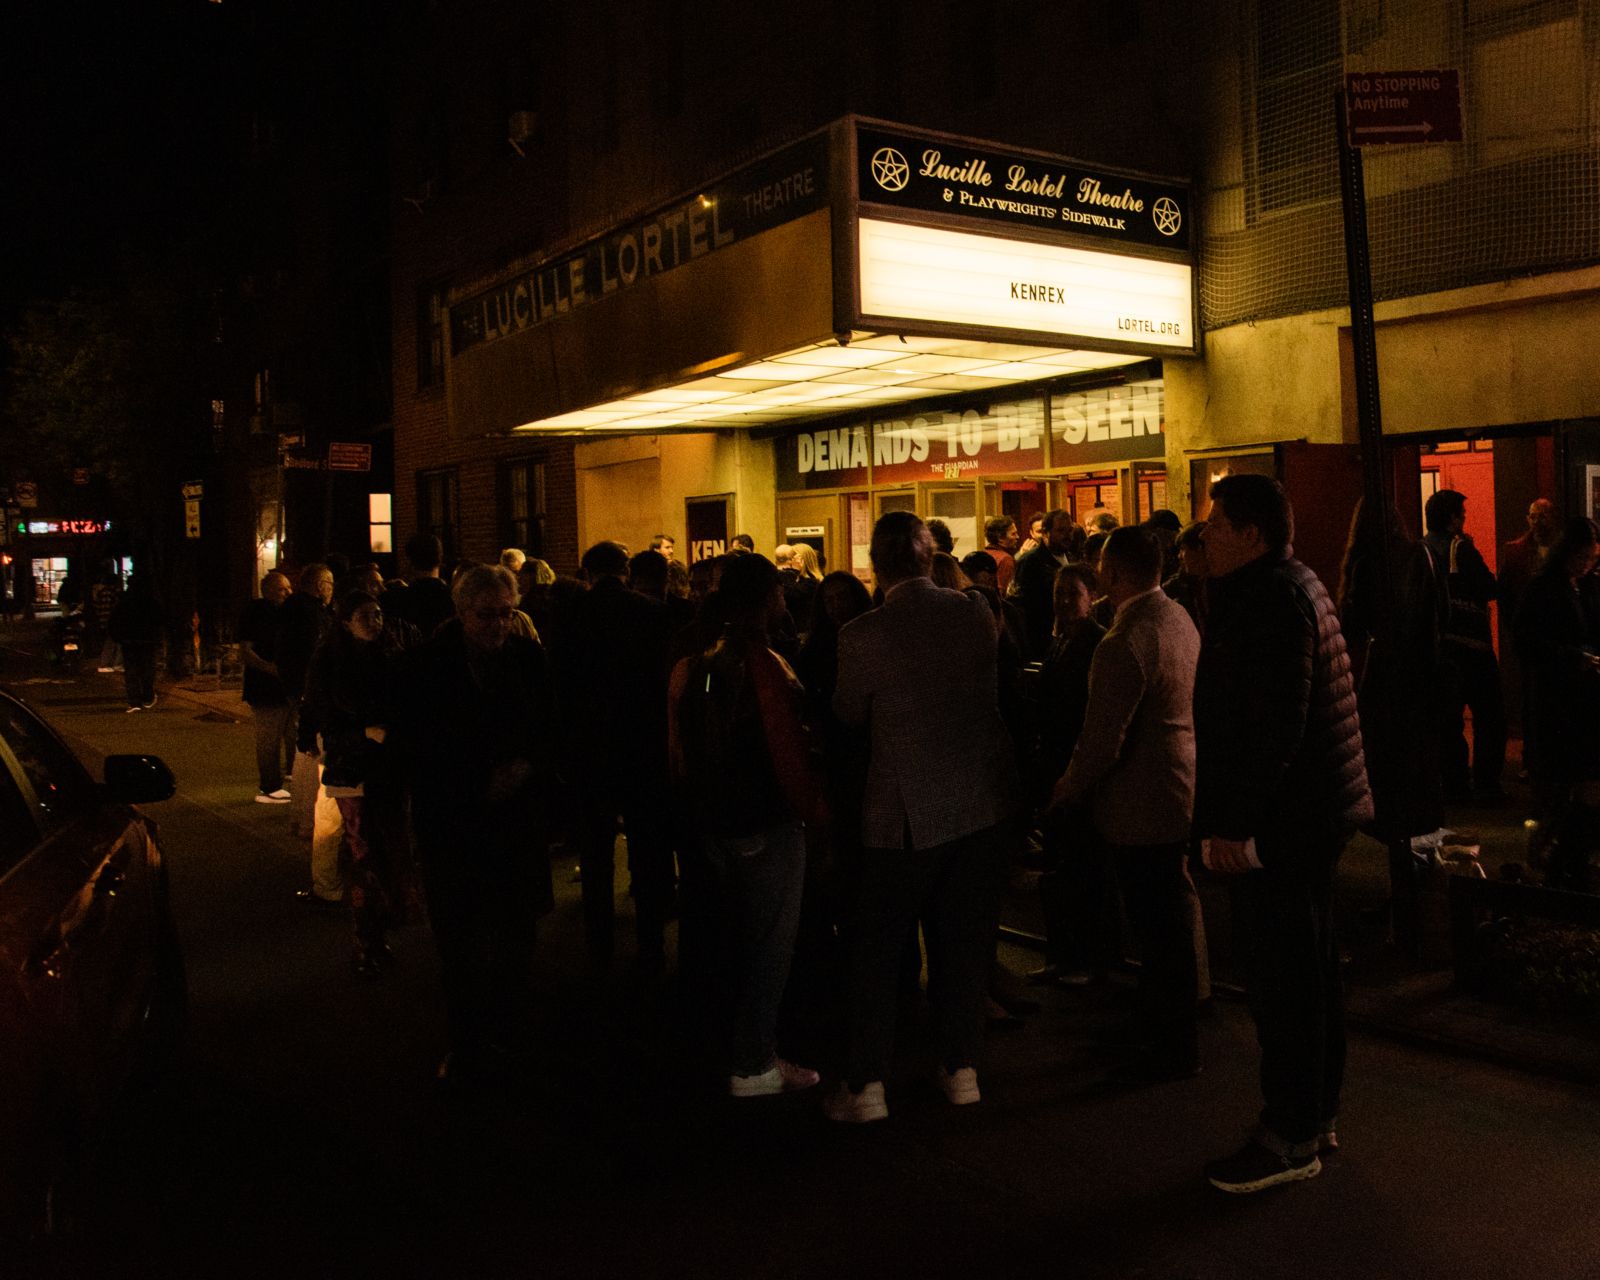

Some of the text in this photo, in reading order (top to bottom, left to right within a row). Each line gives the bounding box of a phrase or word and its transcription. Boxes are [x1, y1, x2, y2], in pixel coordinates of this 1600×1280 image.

[1352, 77, 1440, 93] NO STOPPING
[1354, 96, 1408, 112] Anytime
[919, 150, 1144, 212] Lucille Lortel Theatre
[943, 188, 954, 202] &
[1062, 208, 1126, 230] SIDEWALK
[482, 167, 815, 341] LUCILLE LORTEL THEATRE
[1011, 282, 1065, 304] KENREX
[1118, 318, 1180, 335] LORTEL.ORG
[798, 386, 1160, 473] DEMANDS TO BE SEEN
[930, 463, 944, 473] THE
[944, 460, 979, 471] GUARDIAN
[692, 540, 725, 565] KEN
